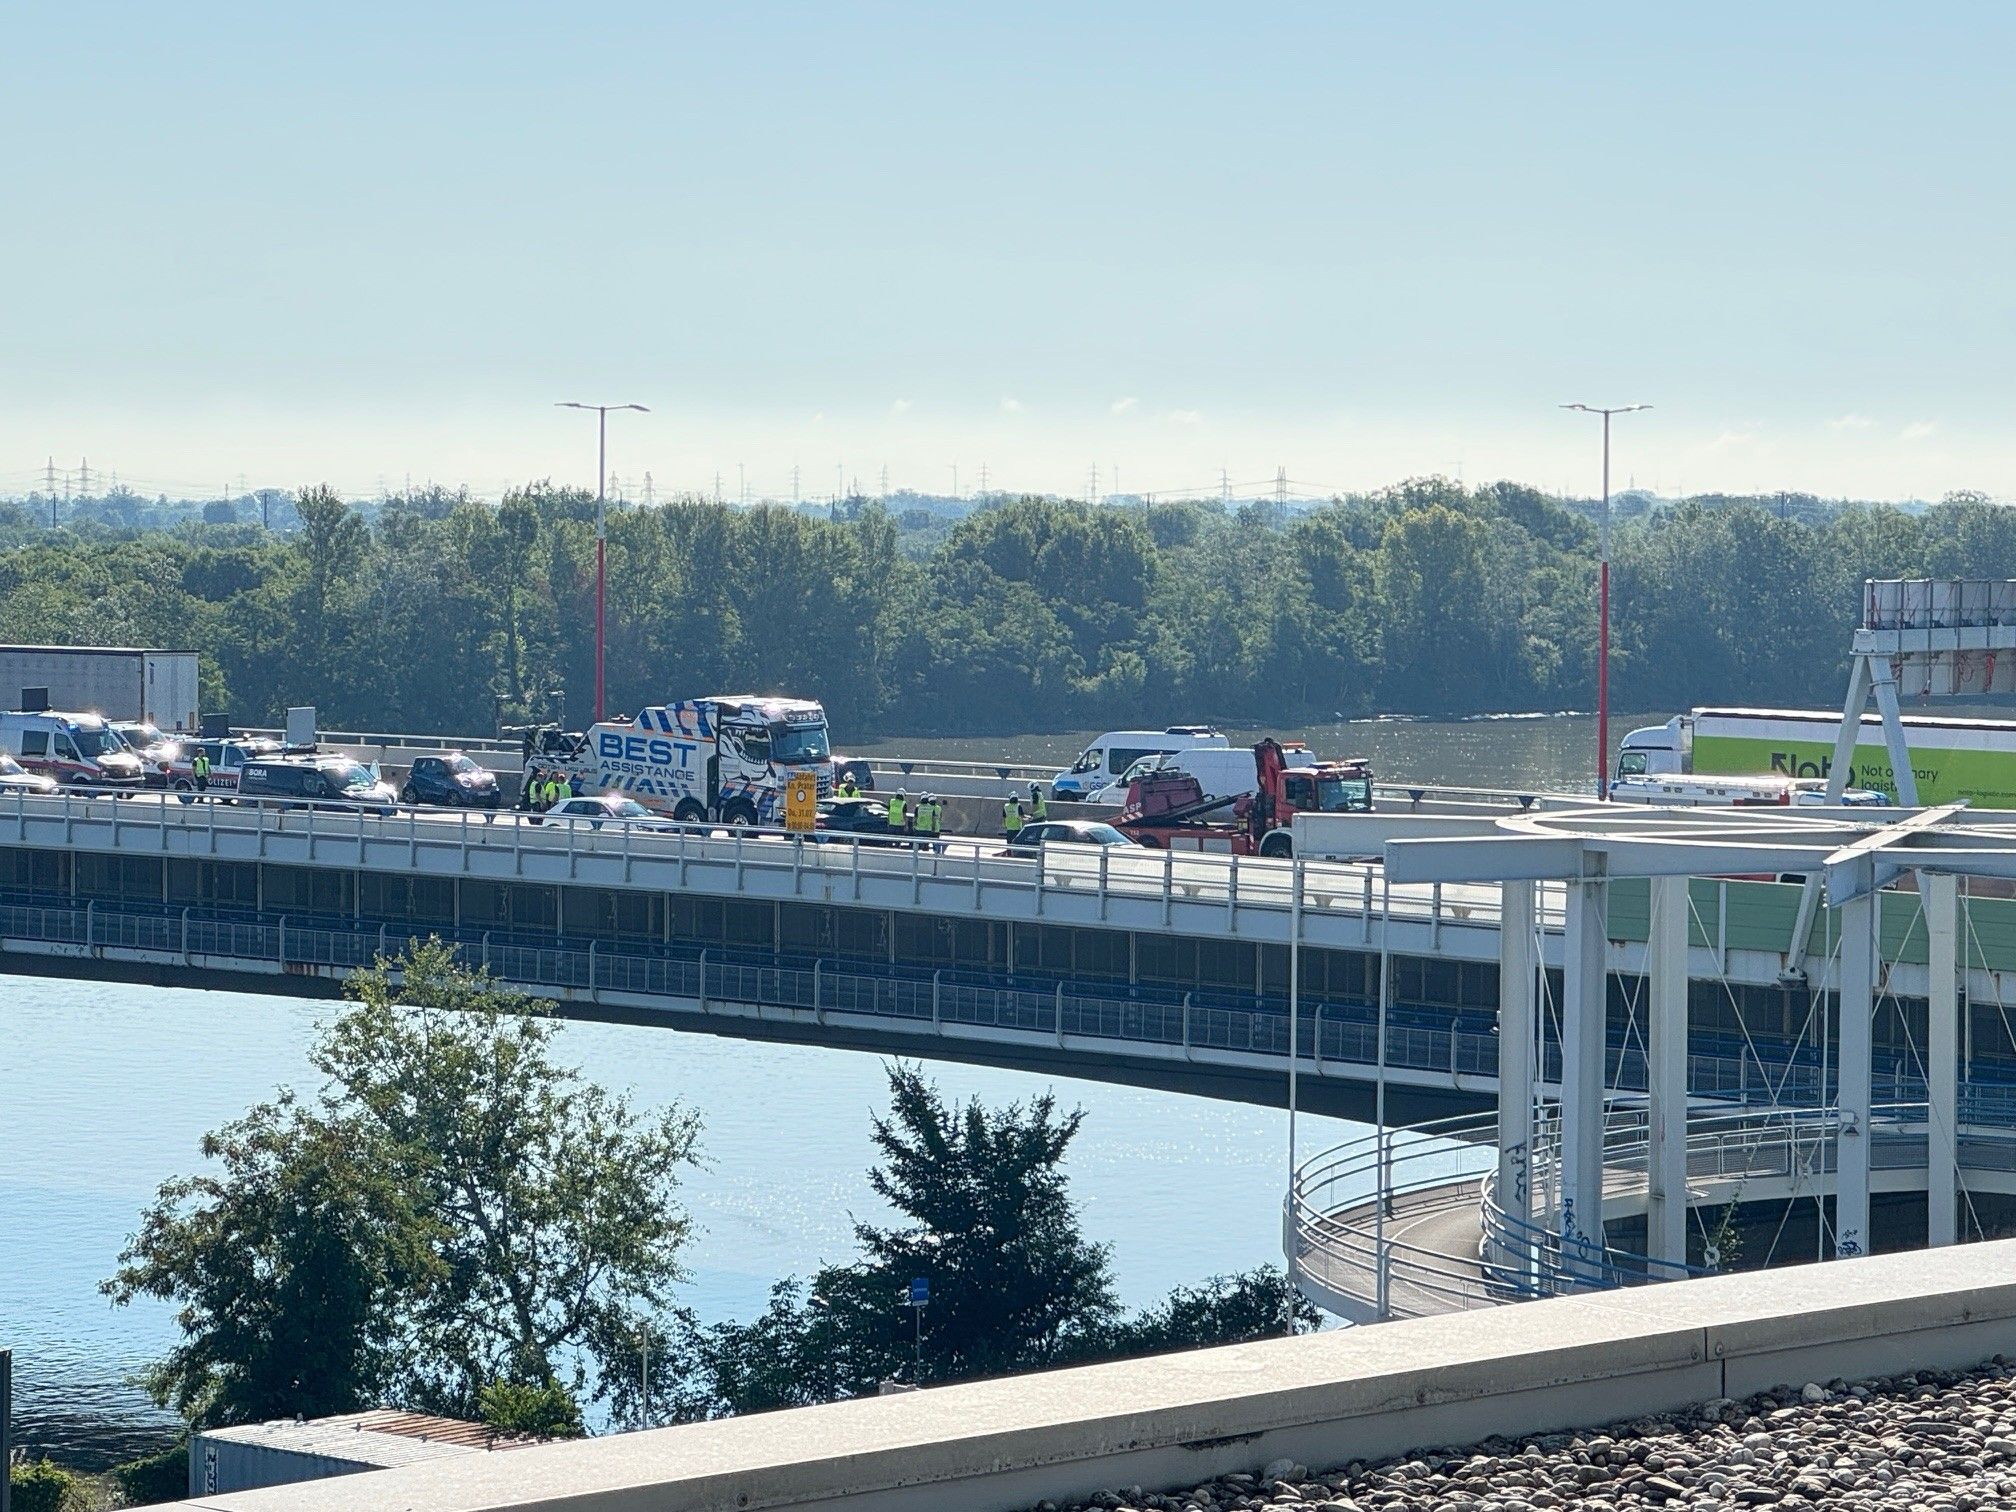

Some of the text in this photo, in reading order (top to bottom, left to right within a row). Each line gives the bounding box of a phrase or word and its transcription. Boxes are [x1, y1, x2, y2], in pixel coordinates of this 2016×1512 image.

[600, 733, 697, 768] BEST
[248, 768, 267, 777] BORA
[600, 760, 695, 781] ASSISTANCE
[1861, 765, 1882, 777] Not
[207, 778, 233, 787] OLIZEI
[1123, 801, 1142, 815] ASP
